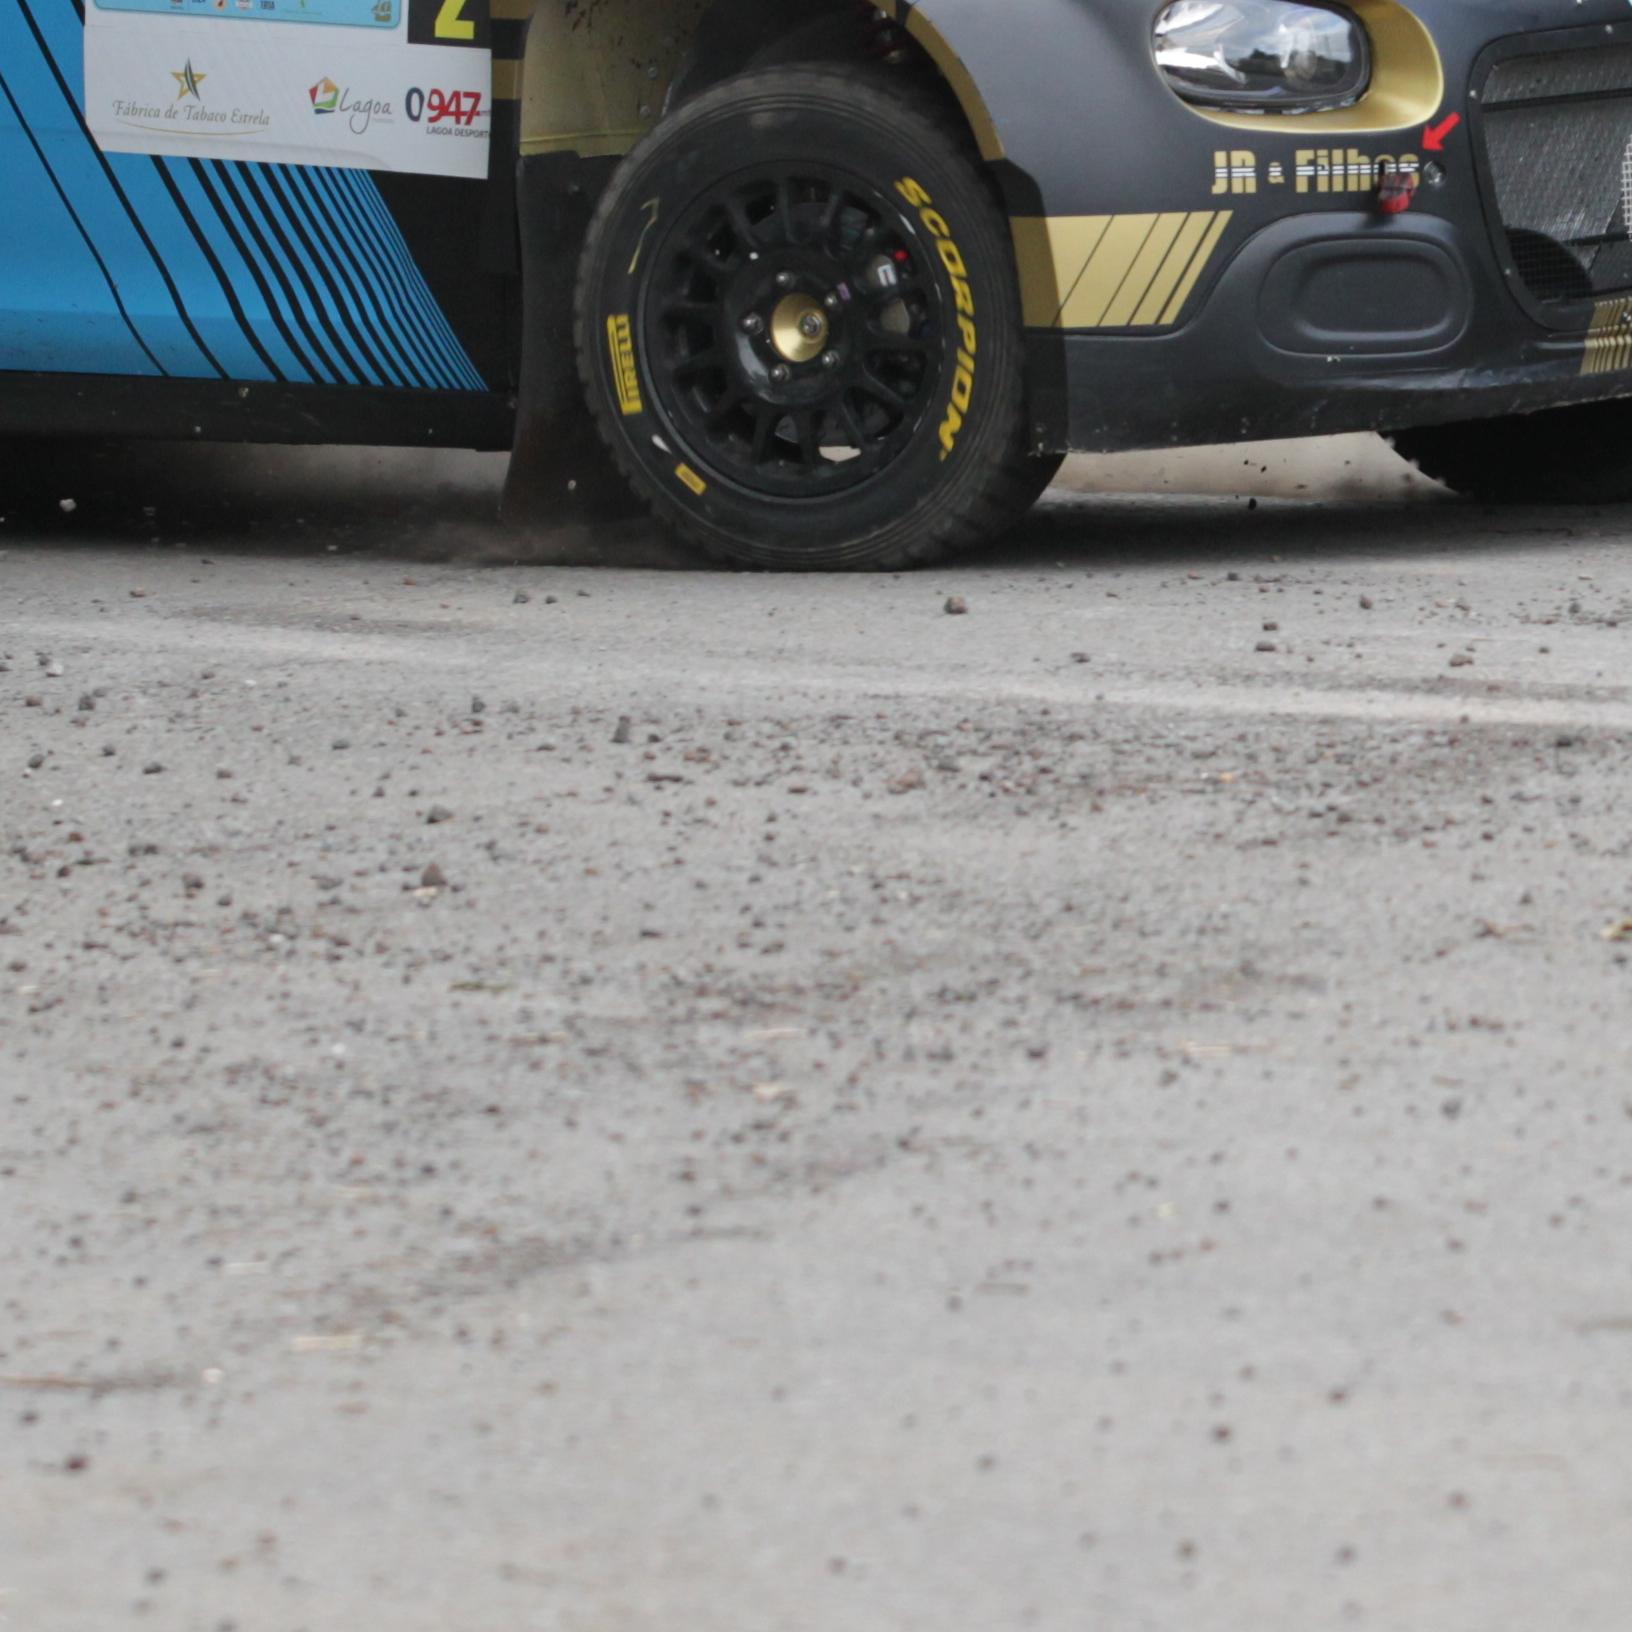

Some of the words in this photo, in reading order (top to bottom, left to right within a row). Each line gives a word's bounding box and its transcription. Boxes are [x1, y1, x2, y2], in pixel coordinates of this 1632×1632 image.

[112, 100, 161, 119] Fábrica
[164, 104, 179, 120] de
[183, 104, 227, 124] Tabaco
[230, 107, 271, 126] Estrela
[339, 87, 392, 135] Lagoa
[426, 127, 453, 136] LAGOA
[1211, 150, 1257, 195] JR
[894, 176, 977, 453] SCORPION
